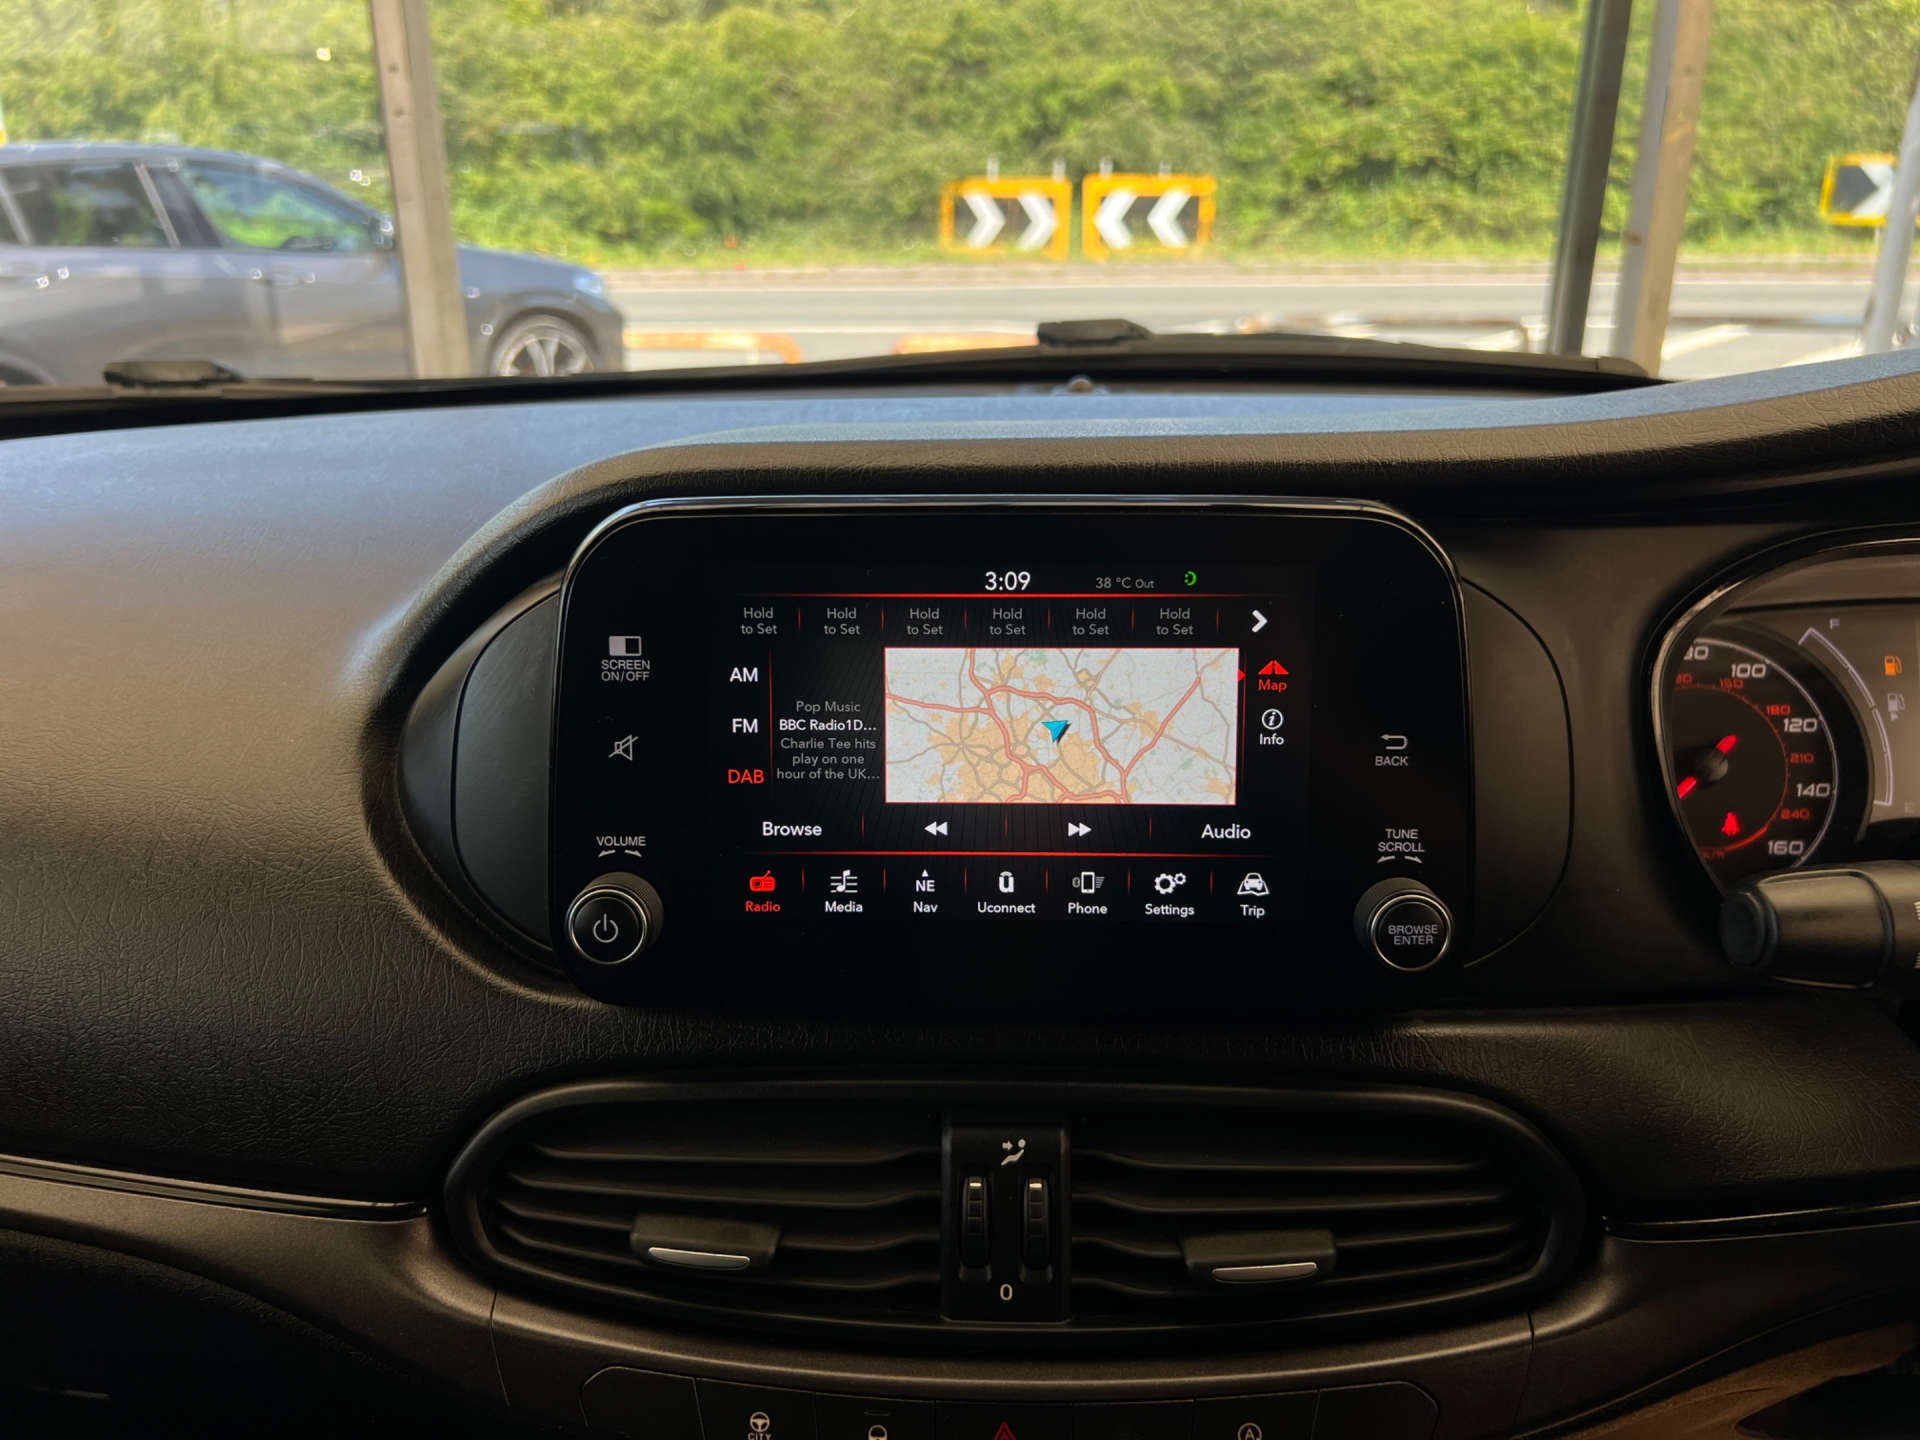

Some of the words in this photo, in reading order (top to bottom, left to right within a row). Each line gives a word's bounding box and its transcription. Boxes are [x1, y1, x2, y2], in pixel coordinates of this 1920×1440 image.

[984, 570, 1031, 591] 3:09
[1095, 576, 1112, 589] 38
[1115, 576, 1132, 589] °C
[1134, 578, 1155, 589] Out
[743, 606, 774, 620] Hold
[826, 607, 857, 620] Hold
[909, 607, 940, 620] Hold
[992, 607, 1023, 620] Hold
[1075, 607, 1107, 620] Hold
[1159, 607, 1191, 620] Hold
[740, 623, 754, 635] to
[756, 622, 778, 635] Set
[823, 624, 837, 635] to
[839, 623, 861, 635] Set
[906, 625, 920, 636] to
[922, 623, 944, 636] Set
[989, 625, 1003, 636] to
[1005, 623, 1026, 636] Set
[1071, 625, 1086, 636] to
[1088, 623, 1110, 636] Set
[1155, 625, 1170, 636] to
[1172, 623, 1194, 636] Set
[1829, 618, 1840, 630] F
[600, 658, 651, 671] SCREEN
[1731, 663, 1766, 678] 100
[600, 670, 651, 683] ON/OFF
[729, 666, 759, 683] AM
[1258, 678, 1288, 693] Map
[795, 700, 821, 715] Pop
[824, 700, 861, 713] Music
[1766, 704, 1791, 715] 180
[732, 717, 759, 734] FM
[779, 718, 807, 731] BBC
[1783, 718, 1817, 733] 120
[780, 736, 825, 750] Charlie
[827, 737, 852, 750] Tee
[854, 737, 877, 750] hits
[1259, 732, 1285, 746] Info
[792, 751, 819, 767] play
[821, 755, 838, 765] on
[840, 755, 865, 765] one
[1374, 755, 1409, 767] BACK
[1790, 753, 1814, 763] 210
[727, 768, 765, 785] DAB
[776, 767, 806, 780] hour
[808, 767, 823, 780] of
[824, 767, 845, 780] the
[1796, 783, 1830, 797] 140
[762, 821, 823, 837] Browse
[1200, 823, 1252, 839] Audio
[1385, 828, 1419, 840] TUNE
[595, 835, 647, 847] VOLUME
[1377, 841, 1425, 853] SCROLL
[1768, 840, 1804, 855] 160
[915, 879, 936, 893] NE
[745, 900, 781, 913] Radio
[824, 900, 864, 913] Media
[913, 900, 939, 913] Nav
[977, 901, 1036, 914] Uconnect
[1067, 901, 1108, 915] Phone
[1144, 903, 1195, 919] Settings
[1239, 903, 1266, 919] Trip
[1388, 924, 1439, 936] BROWSE
[1393, 934, 1434, 946] ENTER
[999, 1283, 1013, 1301] 0
